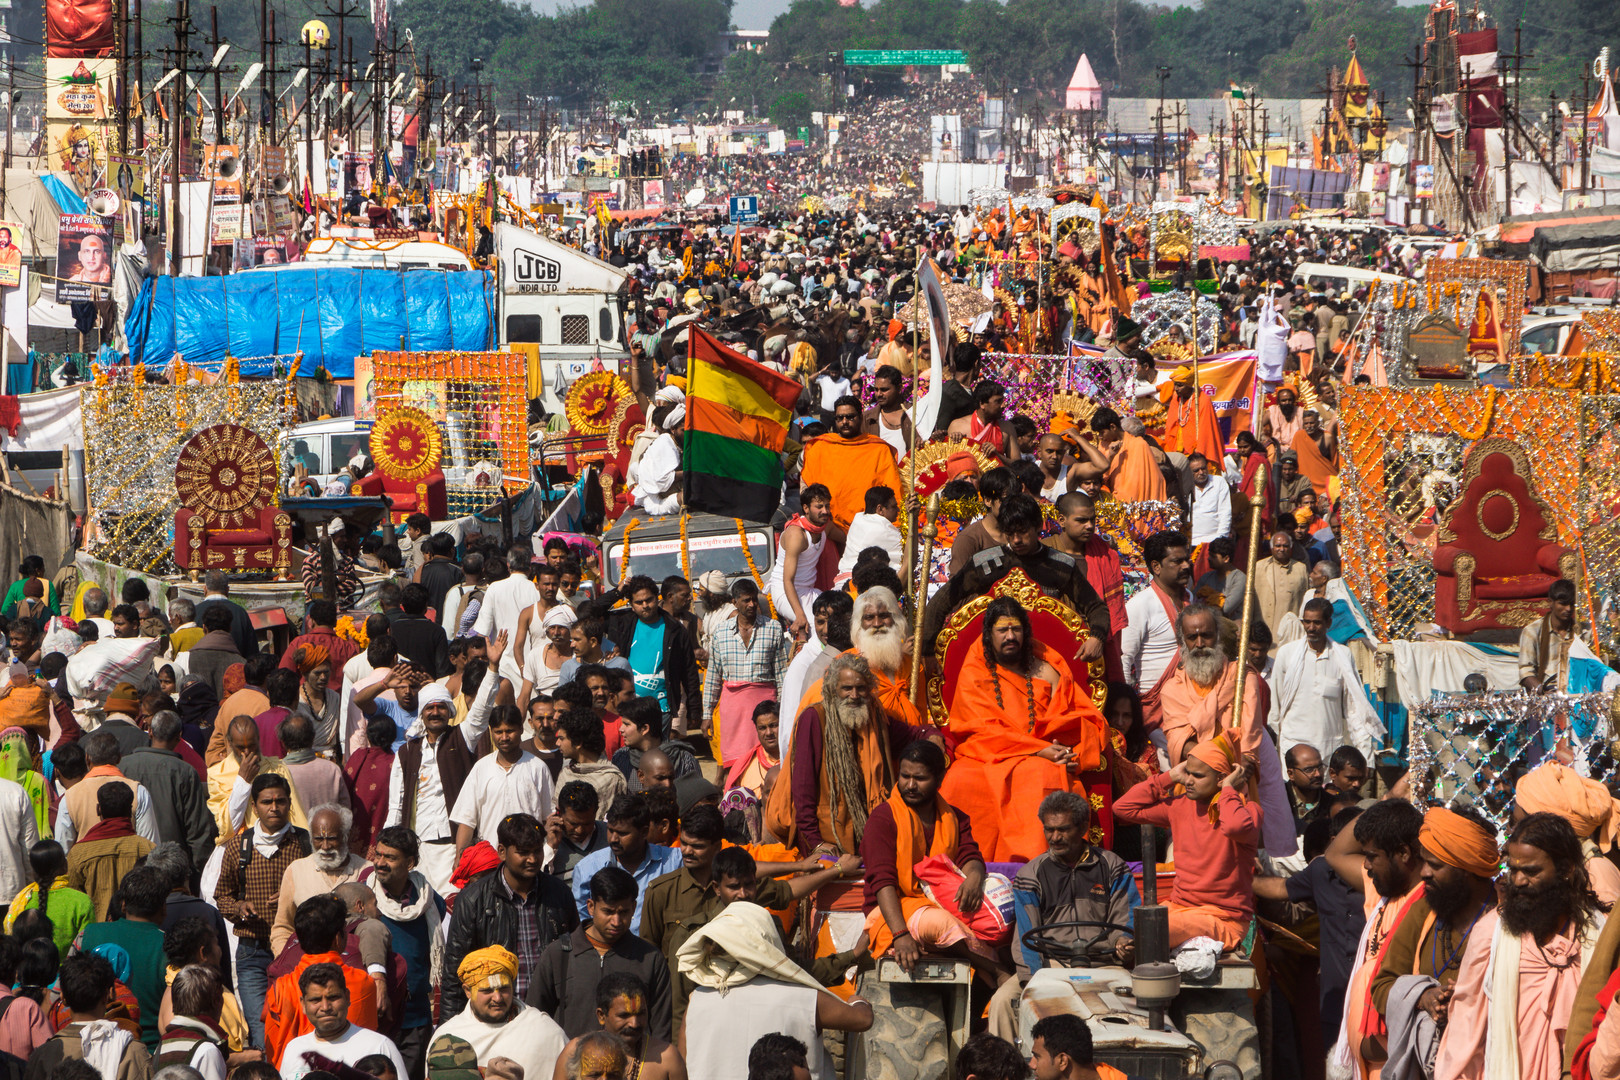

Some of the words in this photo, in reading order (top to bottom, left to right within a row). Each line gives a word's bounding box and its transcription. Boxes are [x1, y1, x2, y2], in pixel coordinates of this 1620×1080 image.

[93, 190, 114, 200] आशा
[517, 254, 557, 280] JCB
[518, 284, 539, 292] INDIA
[541, 284, 559, 292] LTD.
[1236, 396, 1251, 410] जी
[654, 543, 679, 551] कोलाहल
